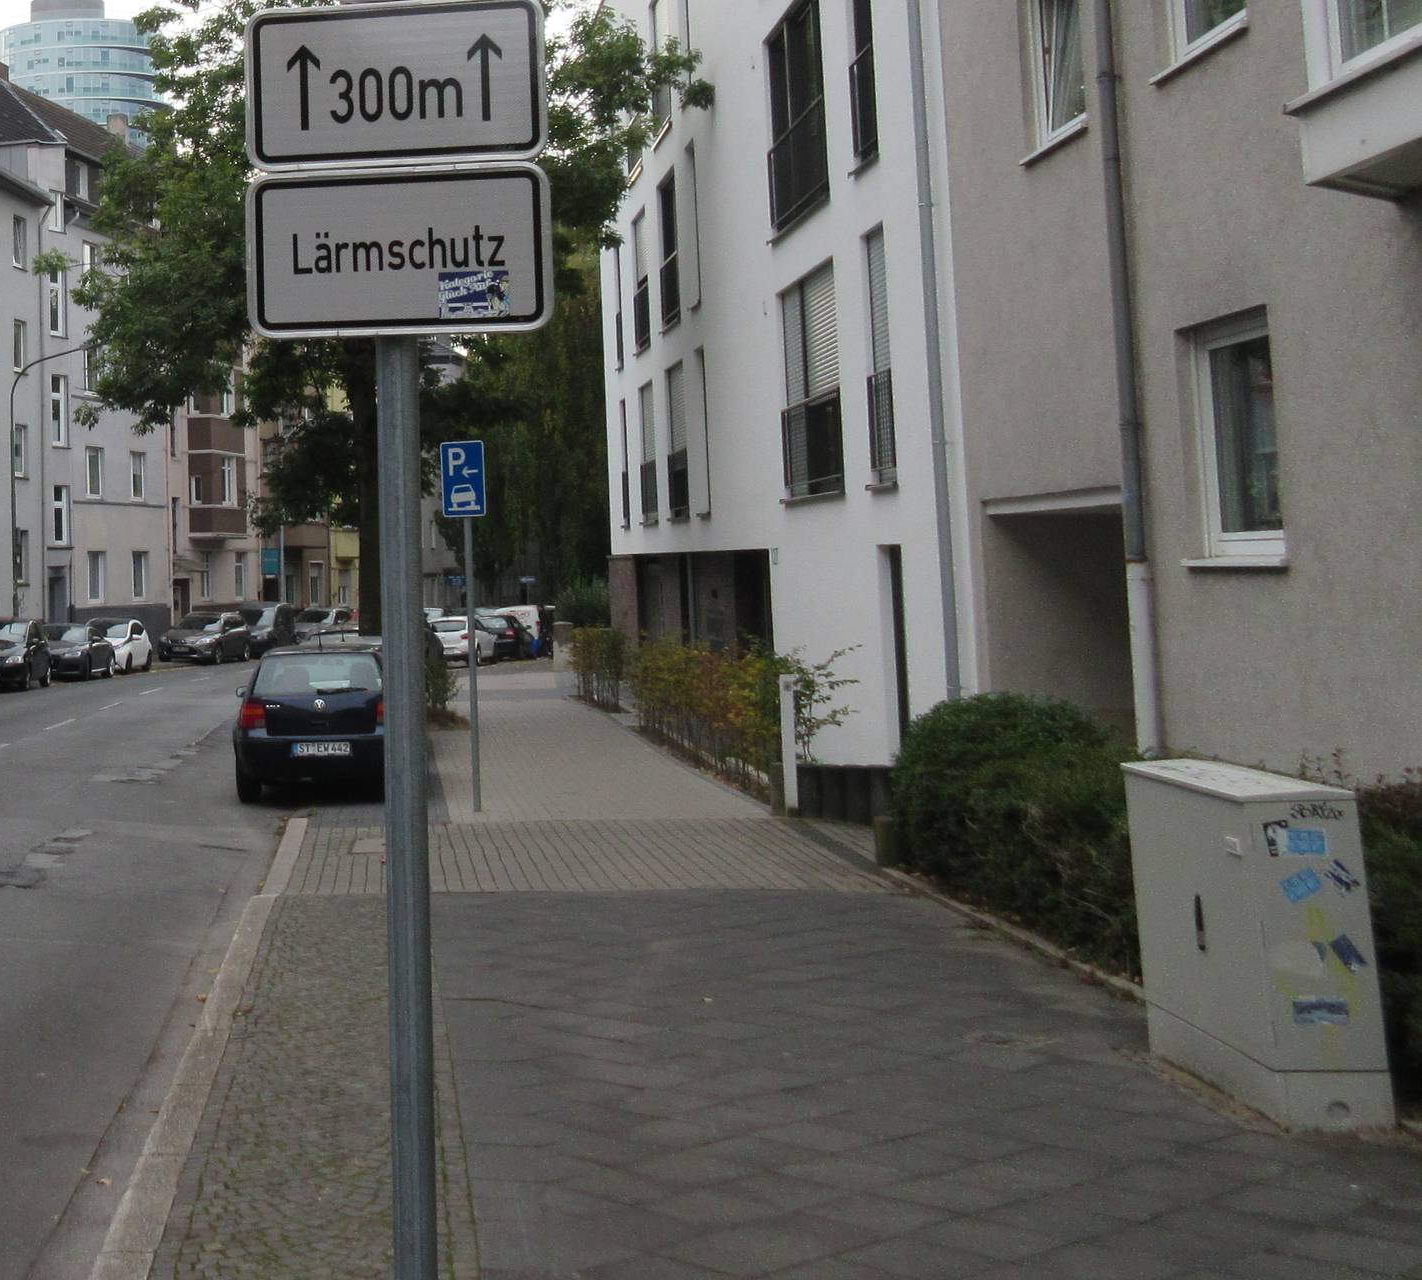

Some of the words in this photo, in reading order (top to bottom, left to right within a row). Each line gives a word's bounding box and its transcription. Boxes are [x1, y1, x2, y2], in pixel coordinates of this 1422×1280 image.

[329, 65, 463, 124] 300m
[292, 224, 506, 275] Lärmschutz
[439, 270, 494, 290] Kategorie
[448, 447, 466, 476] P
